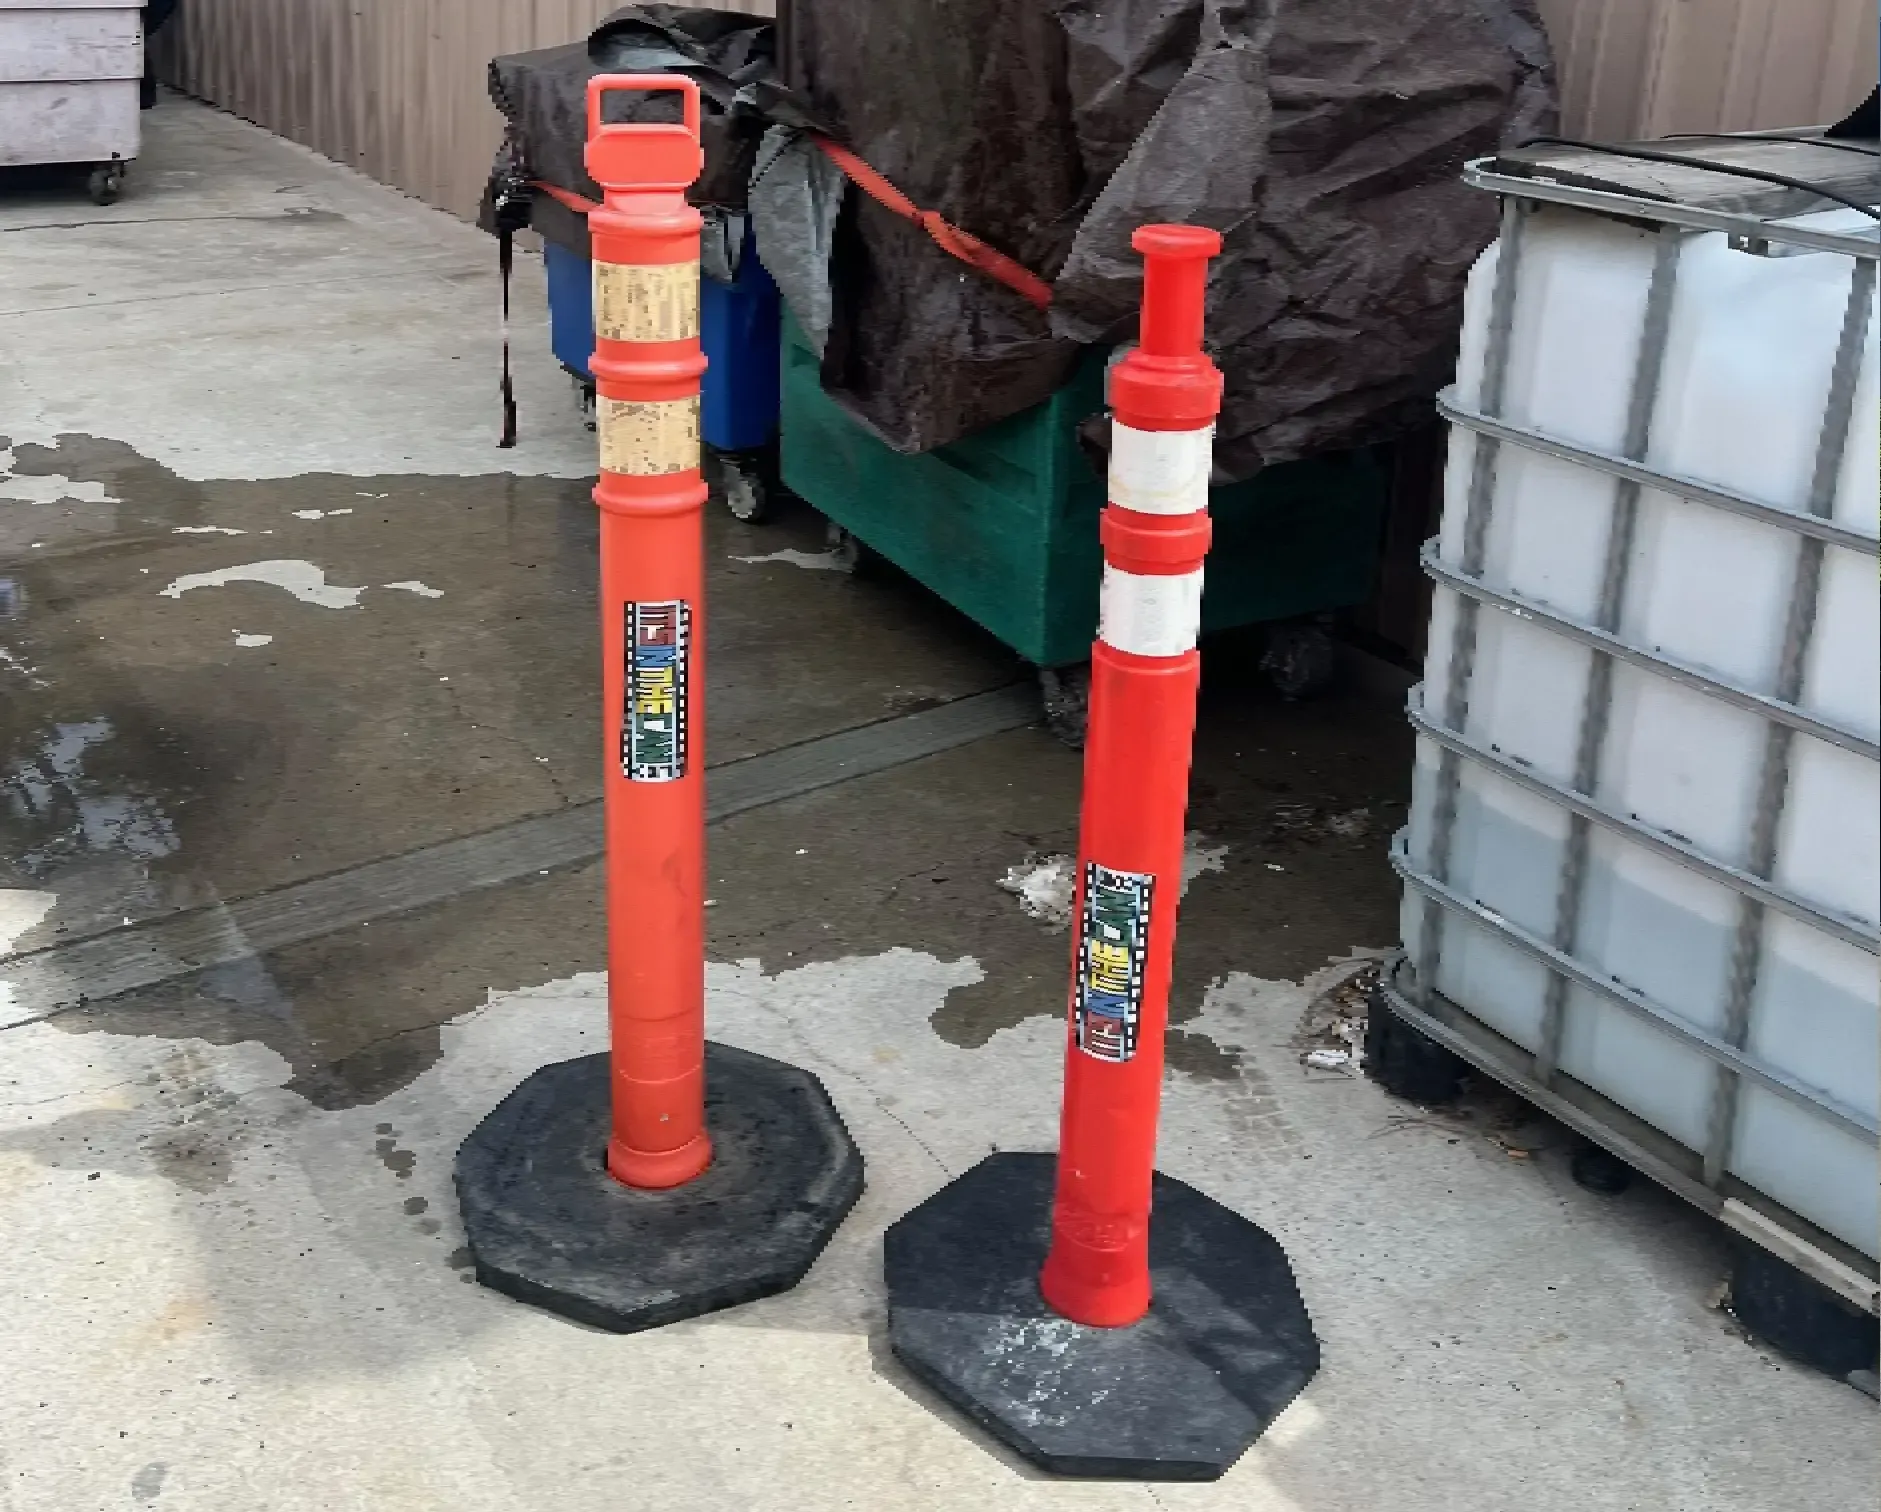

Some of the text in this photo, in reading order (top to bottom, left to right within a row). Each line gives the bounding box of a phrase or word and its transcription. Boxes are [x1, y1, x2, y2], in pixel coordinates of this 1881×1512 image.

[636, 645, 676, 667] IN
[637, 667, 673, 713] THE
[636, 713, 673, 763] CAN
[1093, 887, 1136, 945] CAN
[1091, 940, 1129, 993] THE
[1087, 992, 1127, 1018] IN
